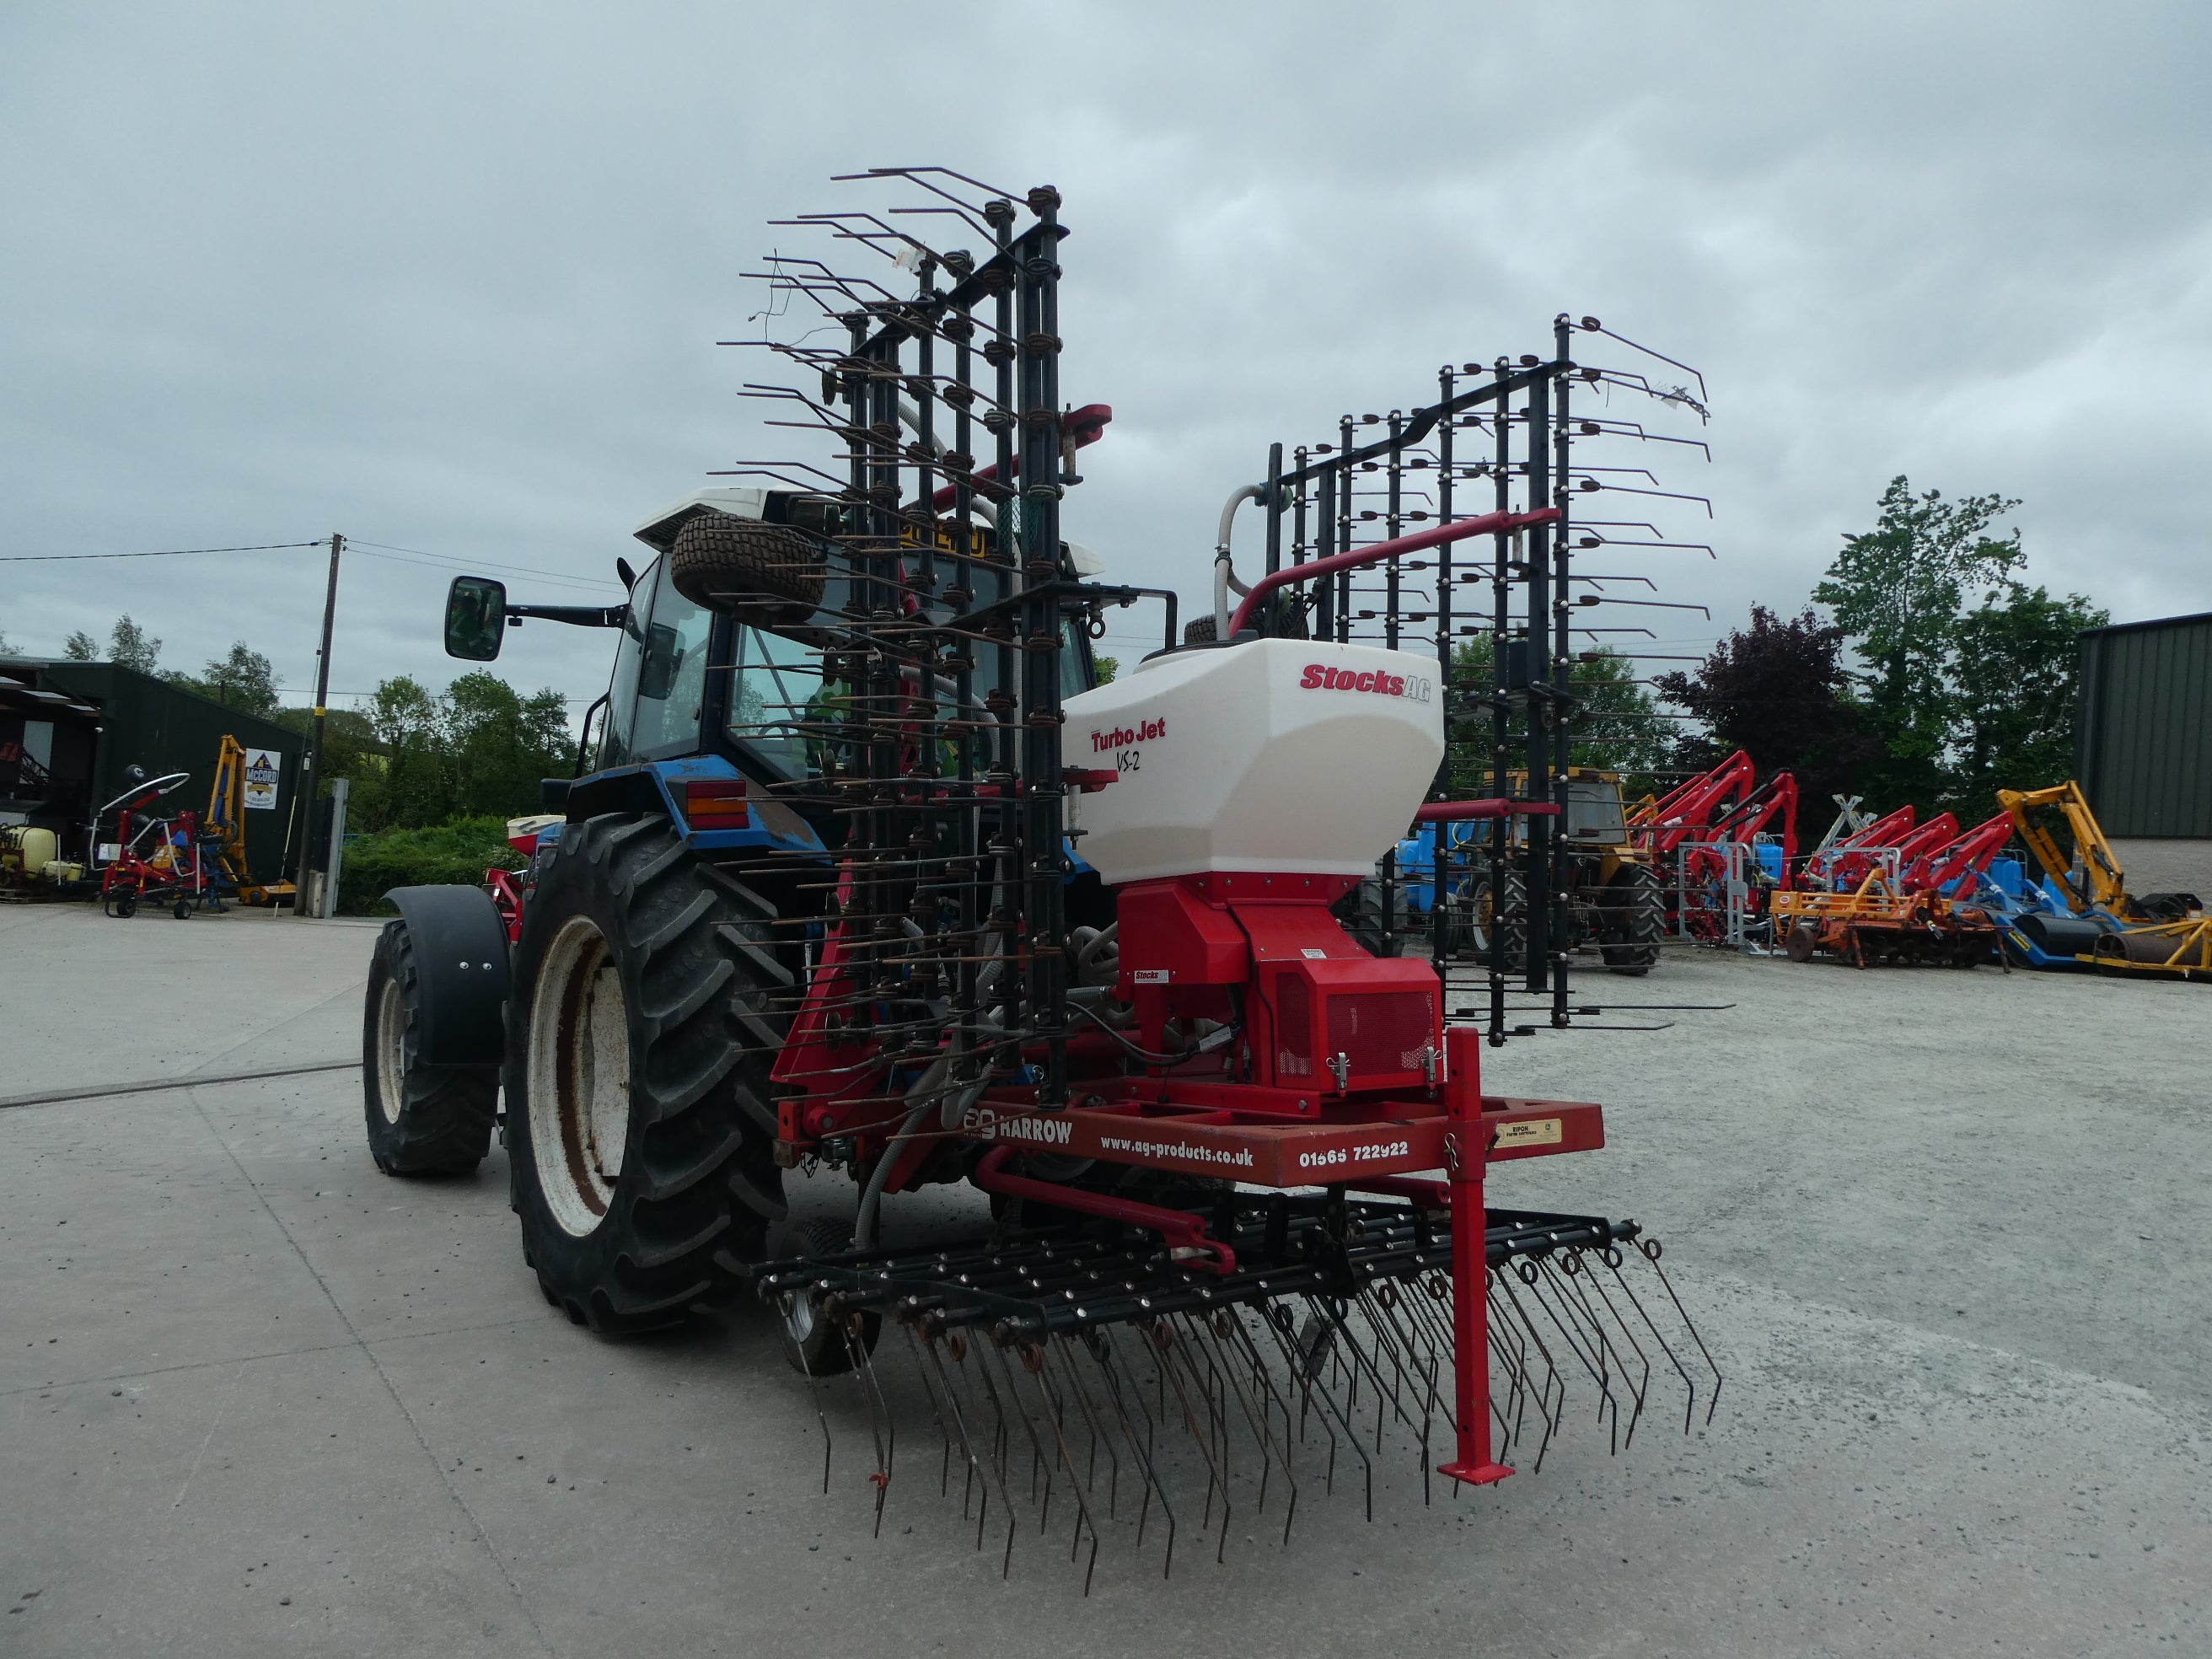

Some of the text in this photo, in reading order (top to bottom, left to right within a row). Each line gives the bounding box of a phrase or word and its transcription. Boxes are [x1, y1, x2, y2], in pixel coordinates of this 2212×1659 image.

[1092, 717, 1166, 753] Turbo Jet
[999, 1114, 1072, 1144] HARROW
[1100, 1136, 1254, 1167] www.ag-products.co.uk
